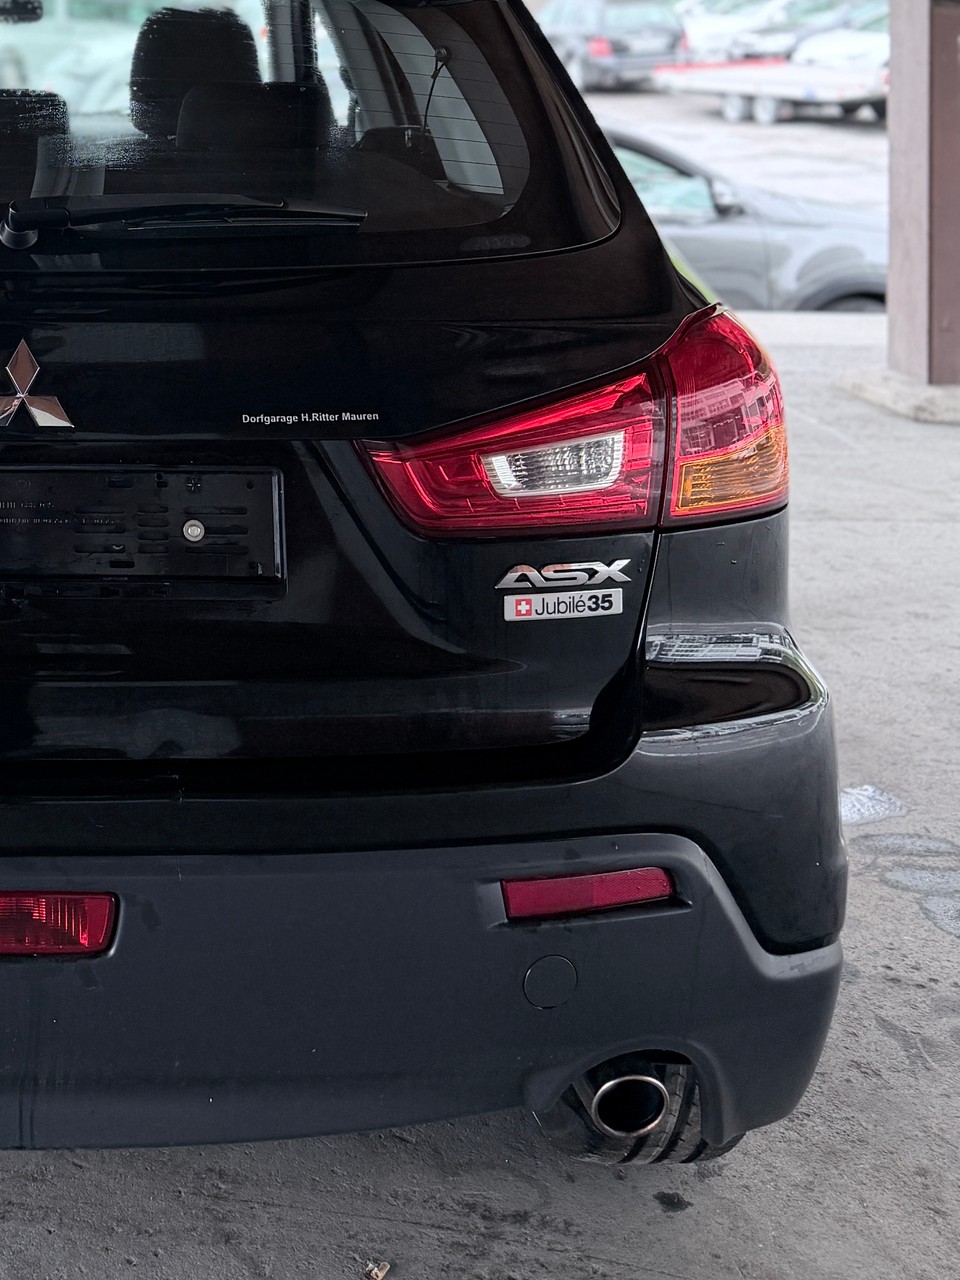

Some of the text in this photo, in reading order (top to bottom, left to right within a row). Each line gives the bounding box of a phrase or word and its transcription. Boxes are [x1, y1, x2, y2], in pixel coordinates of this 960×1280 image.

[242, 412, 379, 425] Dorfgarage H.Ritter Mauren
[494, 558, 632, 589] ASX
